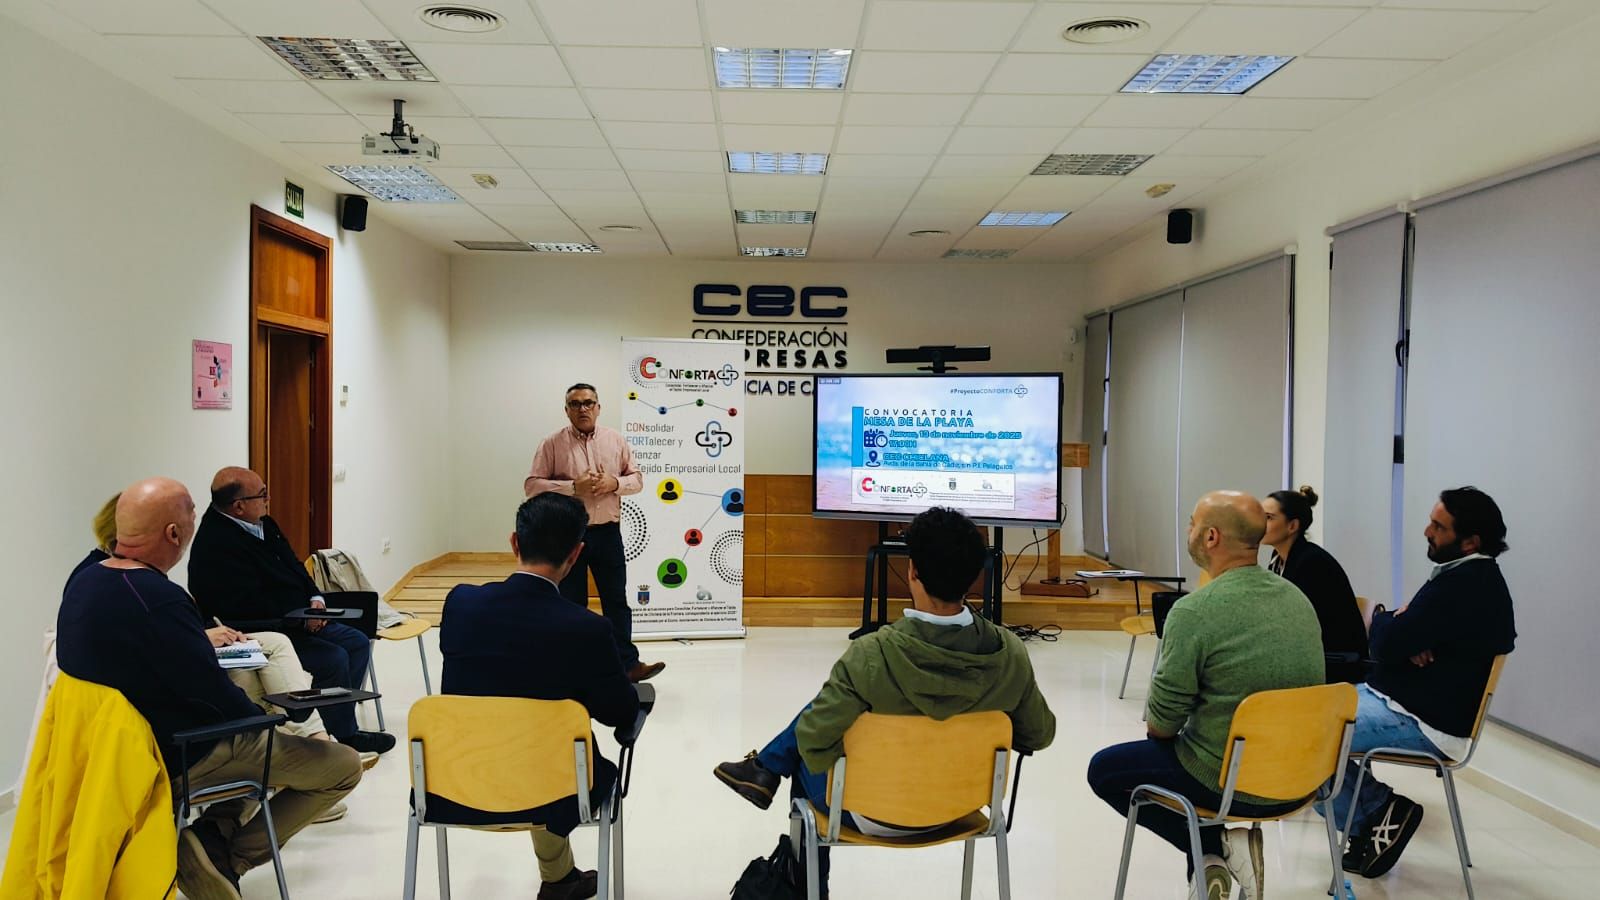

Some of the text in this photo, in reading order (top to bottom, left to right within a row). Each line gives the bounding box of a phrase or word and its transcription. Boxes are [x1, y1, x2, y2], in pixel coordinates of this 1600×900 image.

[777, 380, 796, 396] DE
[864, 408, 973, 416] CONVOCATORIA
[626, 422, 674, 432] CONsolidar
[864, 416, 975, 428] MESA DE LA PLAYA
[678, 439, 684, 448] y
[665, 464, 716, 474] Empresarial
[718, 463, 741, 473] Local
